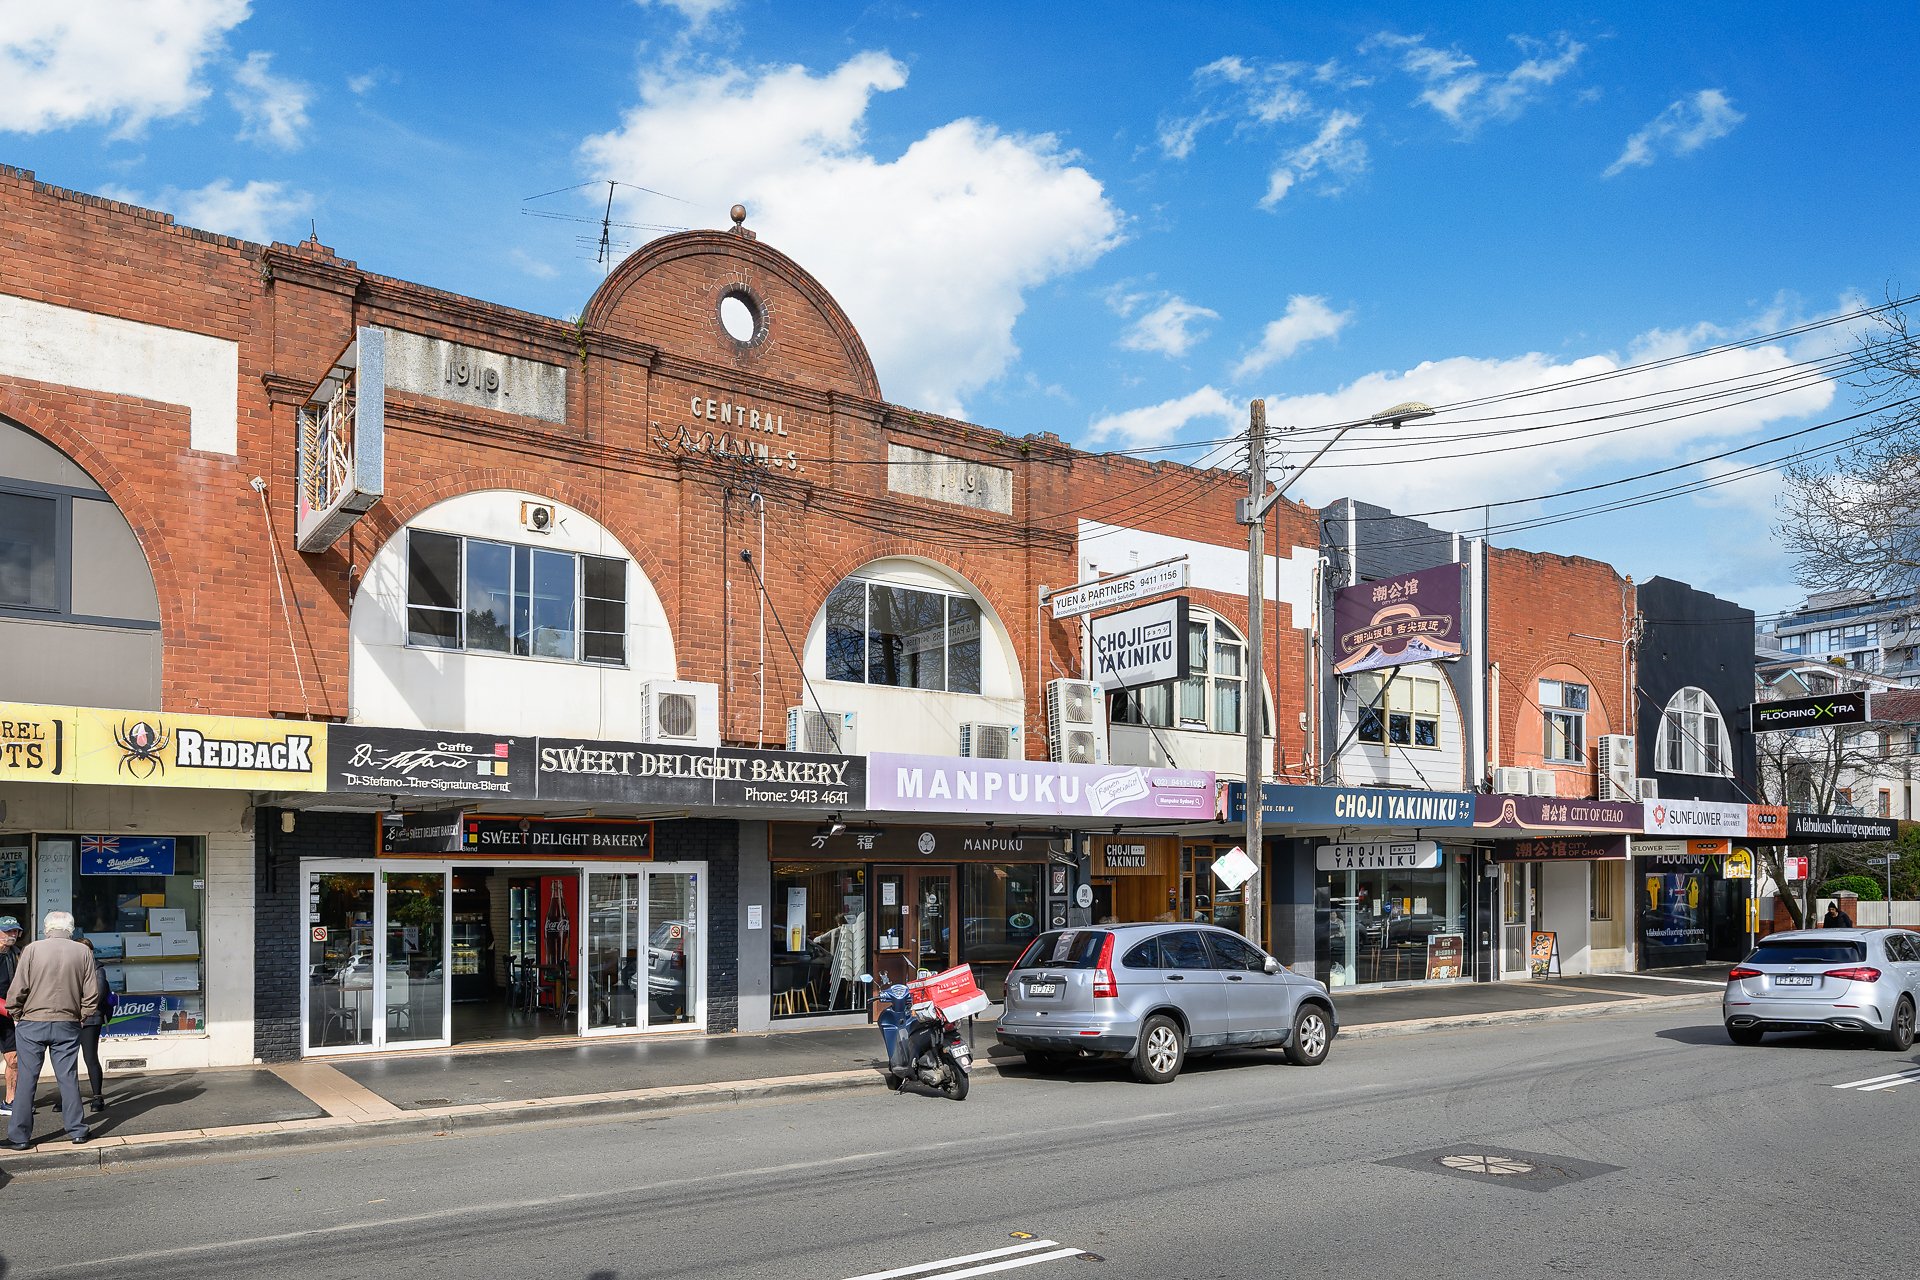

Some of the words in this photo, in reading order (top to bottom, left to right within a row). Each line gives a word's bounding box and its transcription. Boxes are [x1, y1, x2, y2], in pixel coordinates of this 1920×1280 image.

[691, 396, 788, 437] CENTRAL
[1056, 595, 1079, 609] YUEN
[1080, 592, 1087, 603] &
[1088, 580, 1135, 600] PARTNERS
[1140, 575, 1157, 587] 9411
[1160, 570, 1178, 582] 1156
[1372, 578, 1419, 602] 潮公馆
[1098, 626, 1141, 653] CHOJI
[1098, 640, 1172, 673] YAKINIKU
[1760, 708, 1816, 721] FLOORING
[177, 729, 312, 772] REDBACK
[437, 742, 473, 752] Caffe
[540, 744, 634, 776] SWEET
[639, 751, 748, 782] DELIGHT
[749, 759, 849, 787] BAKERY
[430, 778, 478, 791] Signature
[480, 780, 511, 792] Blend
[897, 767, 1080, 804] MANPUKU
[1098, 780, 1120, 793] Ramen
[744, 786, 788, 803] Phone:
[790, 789, 818, 804] 9413
[821, 791, 848, 805] 4641
[1335, 794, 1382, 819] CHOJI
[1387, 795, 1457, 820] YAKINIKU
[1541, 804, 1567, 823] 潮公馆
[1571, 807, 1588, 821] CITY
[1590, 808, 1601, 822] OF
[1602, 808, 1624, 823] CHAO
[1669, 810, 1721, 826] SUNFLOWER
[424, 825, 440, 838] DELIGHT
[1795, 817, 1802, 832] A
[1802, 816, 1831, 833] fabulous
[1831, 818, 1858, 838] flooring
[1858, 822, 1891, 839] experience
[481, 829, 530, 845] SWEET
[533, 832, 590, 846] DELIGHT
[592, 833, 647, 848] BAKERY
[964, 838, 1023, 851] MANPUKU
[1106, 844, 1130, 856] CHOJI
[1335, 845, 1383, 857] CHOJI
[1516, 841, 1567, 857] 潮公馆
[1582, 848, 1605, 856] CHAO
[107, 855, 150, 869] Blundstone
[1107, 855, 1146, 867] YAKINIKU
[1335, 855, 1416, 868] YAKINIKU
